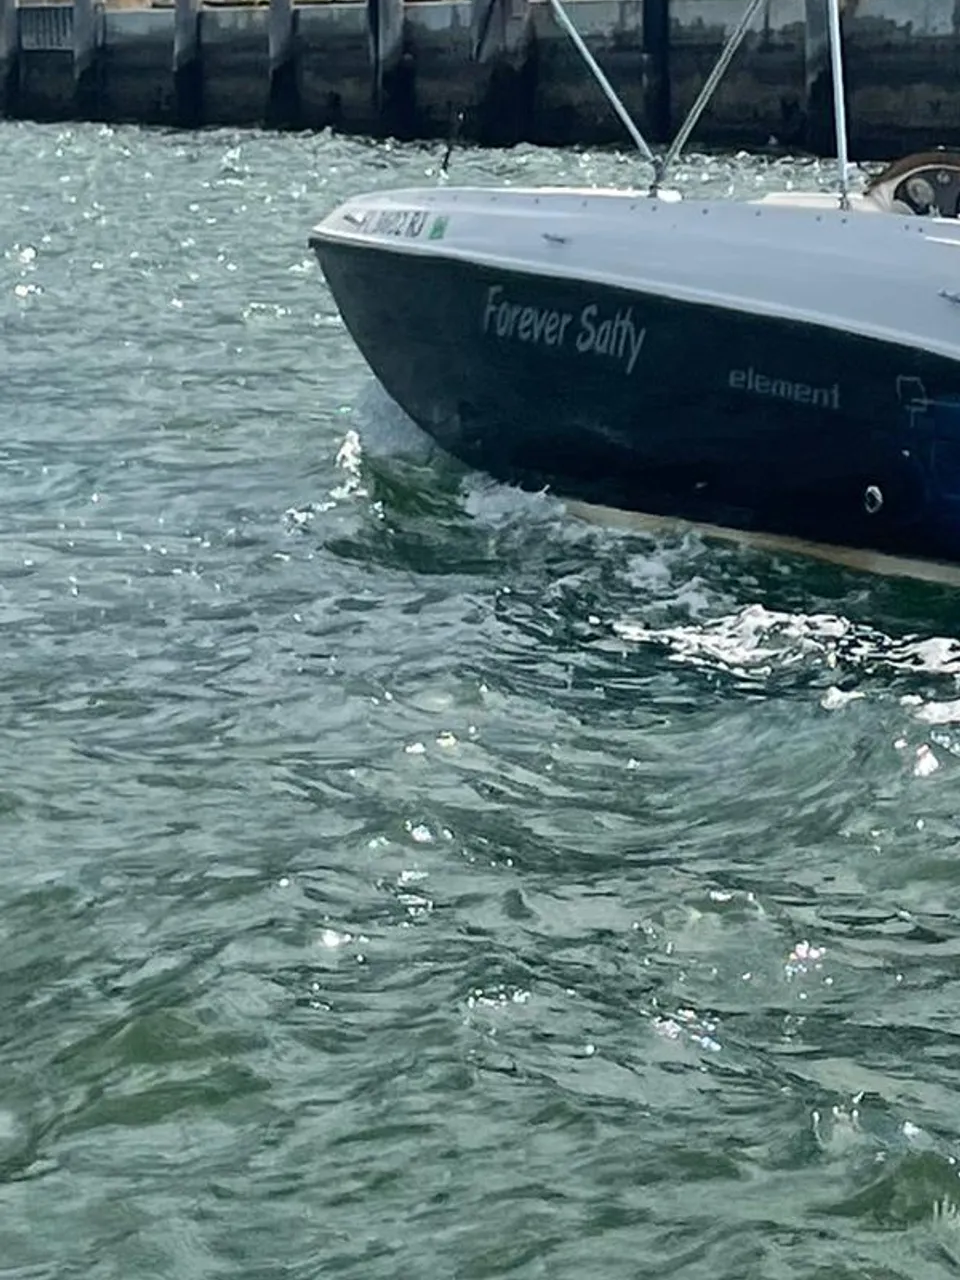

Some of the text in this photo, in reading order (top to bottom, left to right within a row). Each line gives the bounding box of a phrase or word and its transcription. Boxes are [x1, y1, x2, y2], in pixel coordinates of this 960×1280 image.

[483, 285, 647, 375] Forever Salty
[728, 365, 843, 410] element
